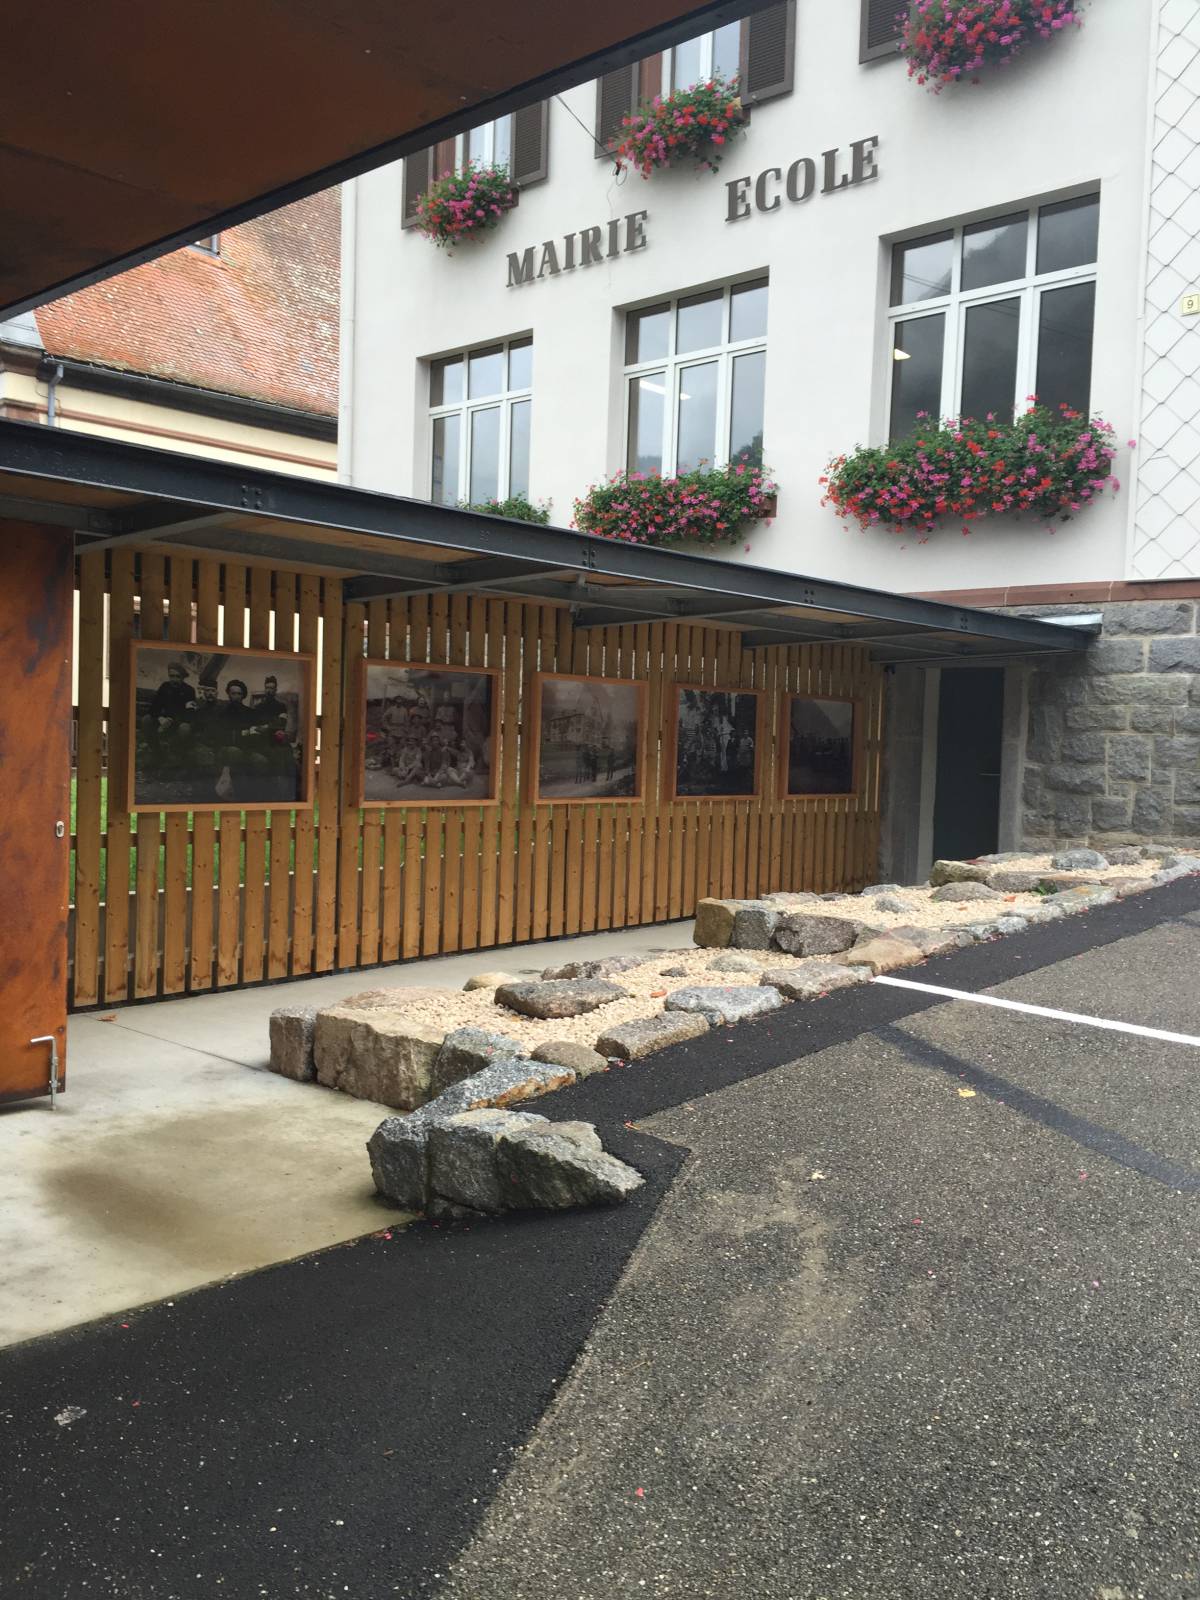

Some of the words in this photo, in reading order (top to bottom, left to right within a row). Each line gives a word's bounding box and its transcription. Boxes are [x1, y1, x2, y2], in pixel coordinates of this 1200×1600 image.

[506, 209, 648, 288] MAIRIE
[725, 135, 880, 223] ECOLE
[1187, 299, 1194, 309] 9
